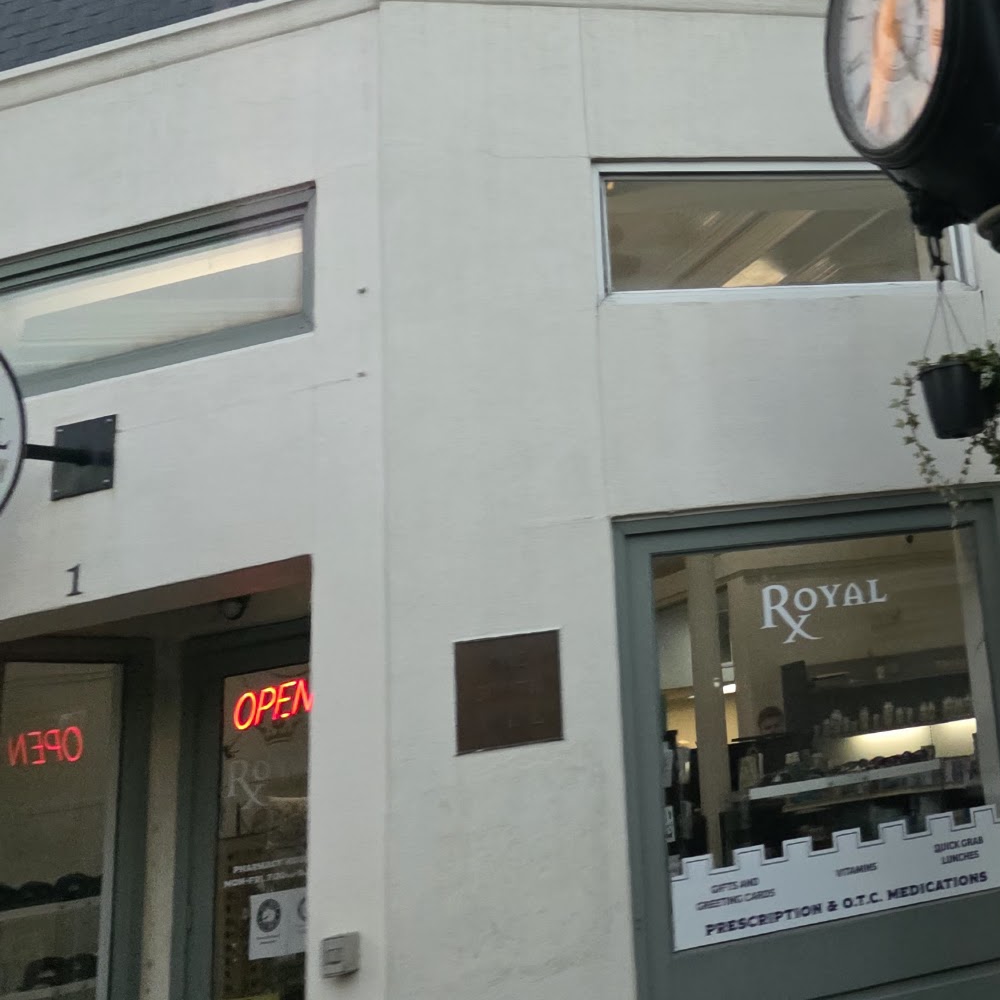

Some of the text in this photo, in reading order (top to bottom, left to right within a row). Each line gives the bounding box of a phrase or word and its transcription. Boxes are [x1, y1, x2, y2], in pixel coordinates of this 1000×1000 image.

[65, 563, 83, 597] 1
[760, 579, 888, 632] ROYAL
[233, 678, 313, 730] OPEN
[934, 836, 984, 854] QUICK GRAB
[941, 849, 980, 865] LUNCHES
[835, 862, 878, 877] VITAMINS
[705, 871, 988, 937] PRESCRIPTION & O.T.C. MEDICATIONS
